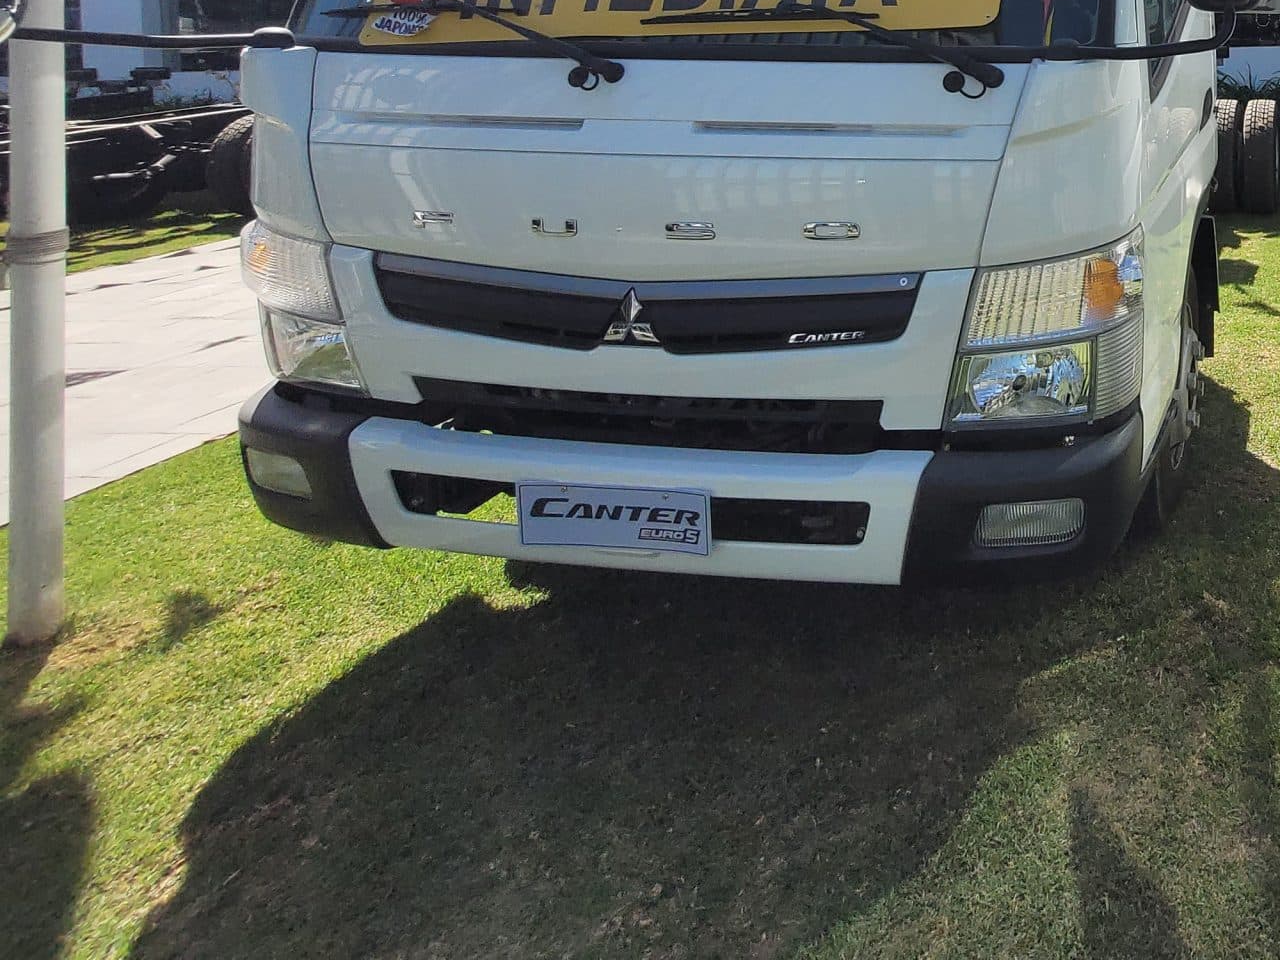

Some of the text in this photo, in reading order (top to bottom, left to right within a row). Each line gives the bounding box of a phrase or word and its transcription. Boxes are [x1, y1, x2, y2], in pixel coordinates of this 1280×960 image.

[413, 209, 861, 240] FUSO
[788, 329, 866, 344] CANTER
[530, 497, 701, 527] CANTER
